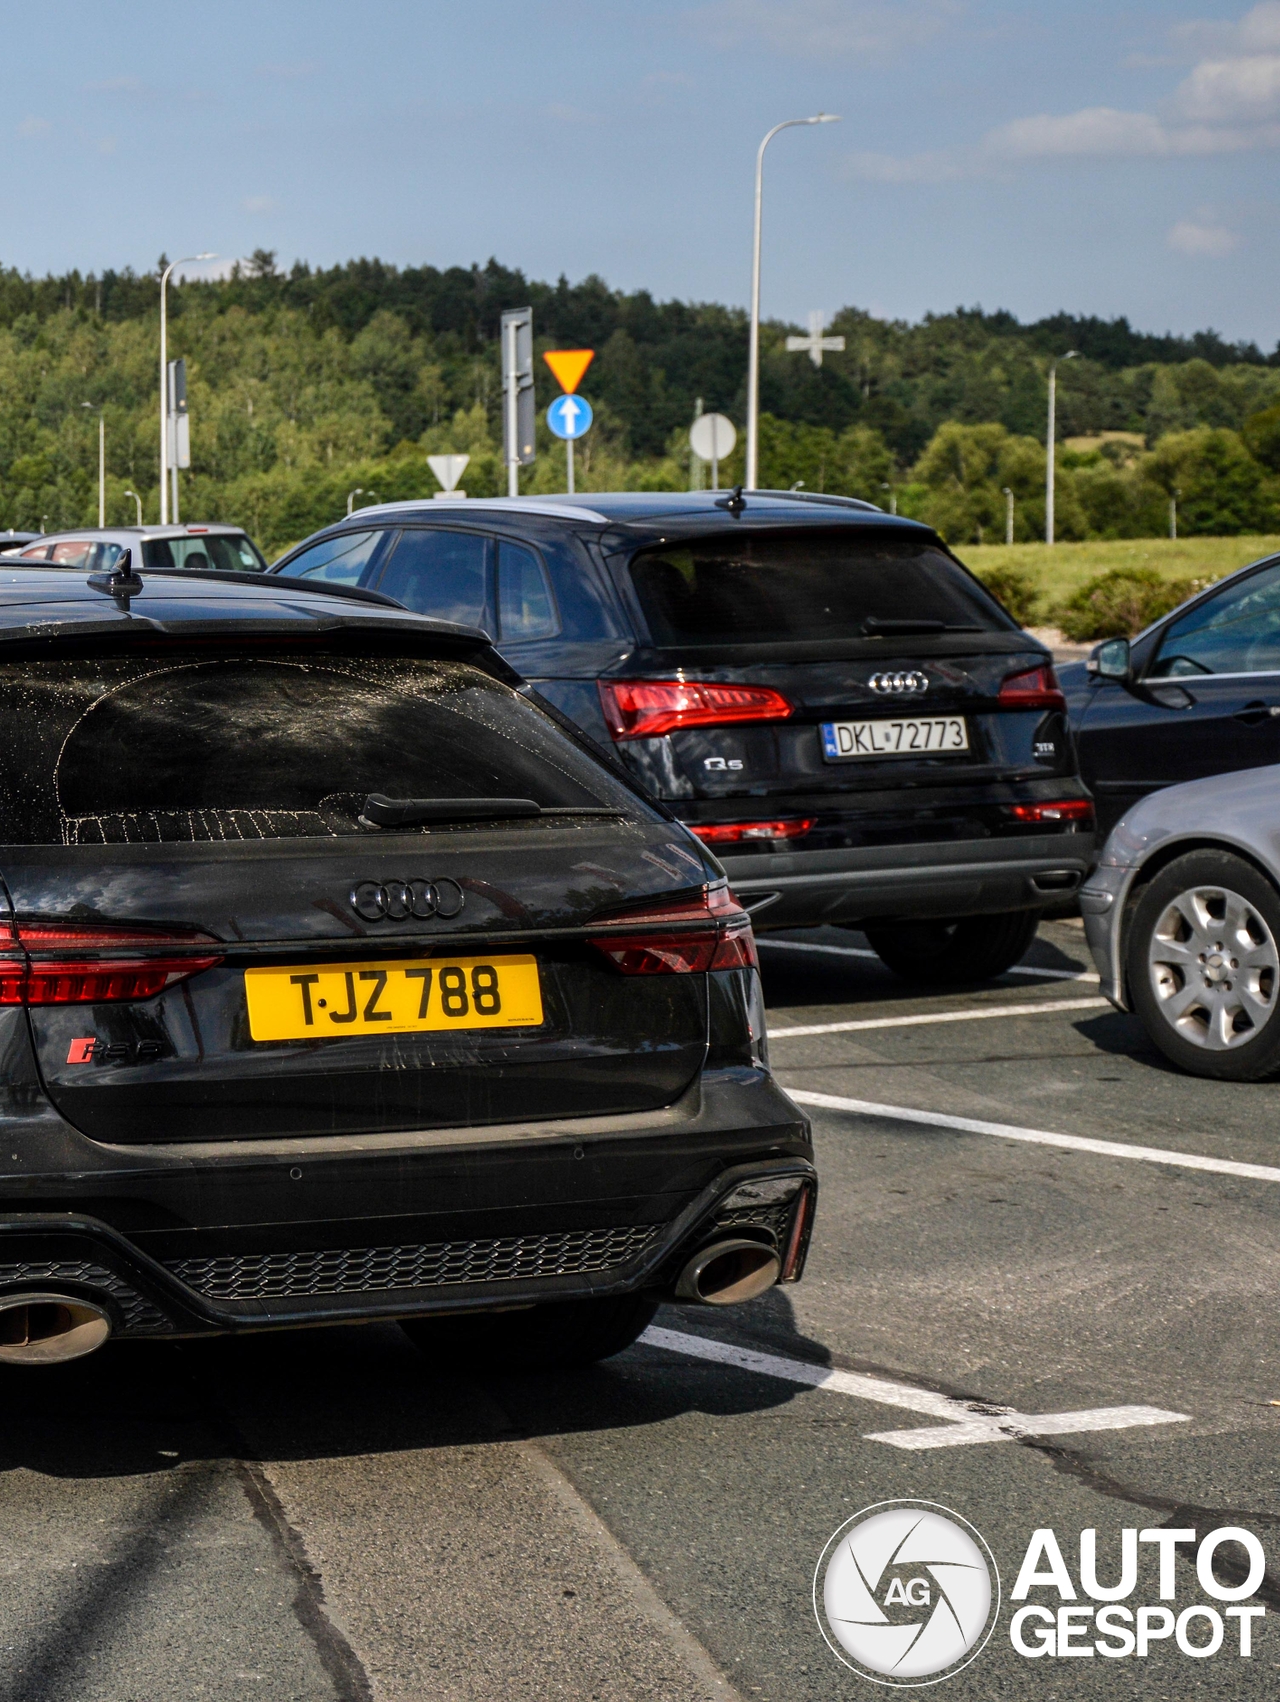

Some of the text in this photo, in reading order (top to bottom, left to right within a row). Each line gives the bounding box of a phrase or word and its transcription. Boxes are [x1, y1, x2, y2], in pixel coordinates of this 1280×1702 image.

[837, 720, 964, 753] DKL 72773
[704, 757, 743, 770] Q5
[289, 964, 502, 1026] TJZ 788
